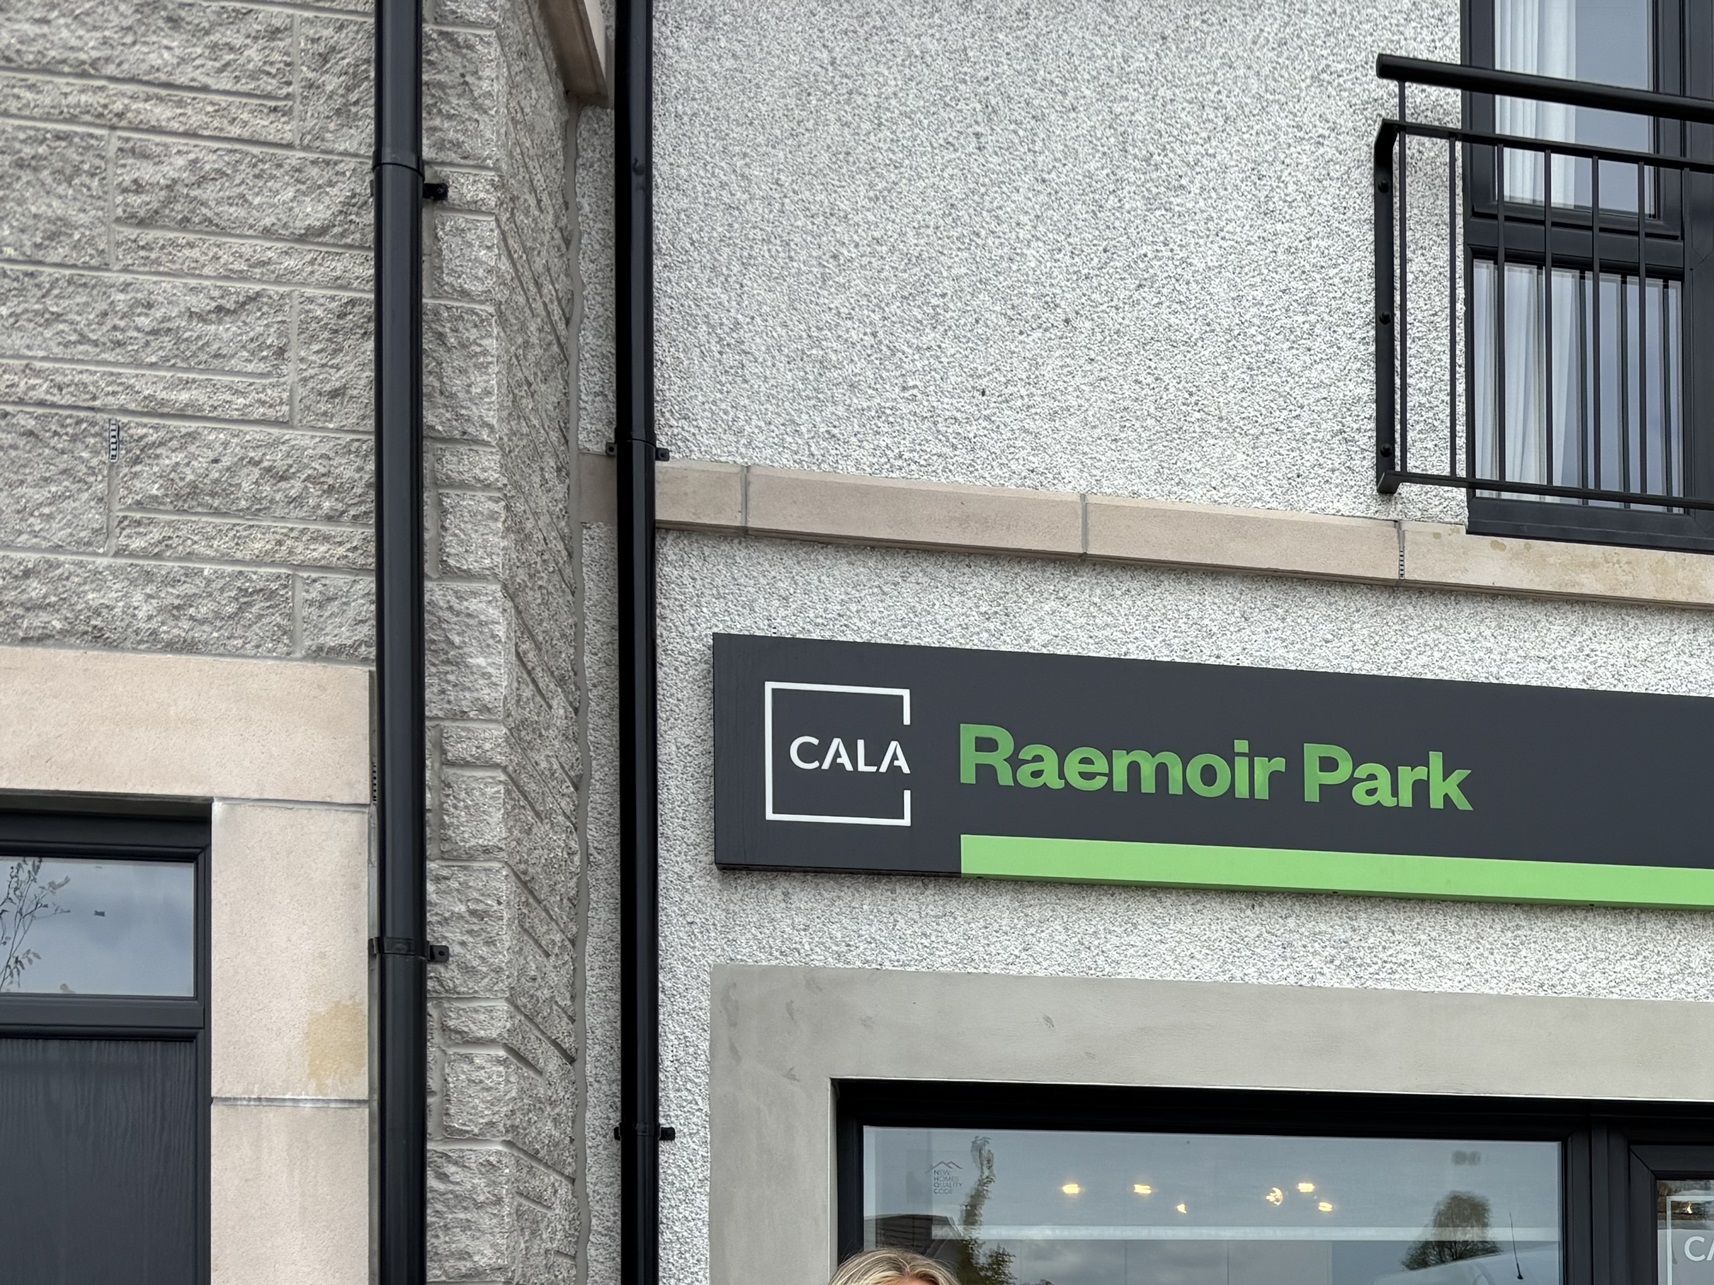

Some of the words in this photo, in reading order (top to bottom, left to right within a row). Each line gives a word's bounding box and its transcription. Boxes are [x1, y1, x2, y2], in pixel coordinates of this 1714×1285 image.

[789, 735, 911, 775] CALA
[959, 723, 1286, 801] Raemoir
[1303, 742, 1474, 811] Park
